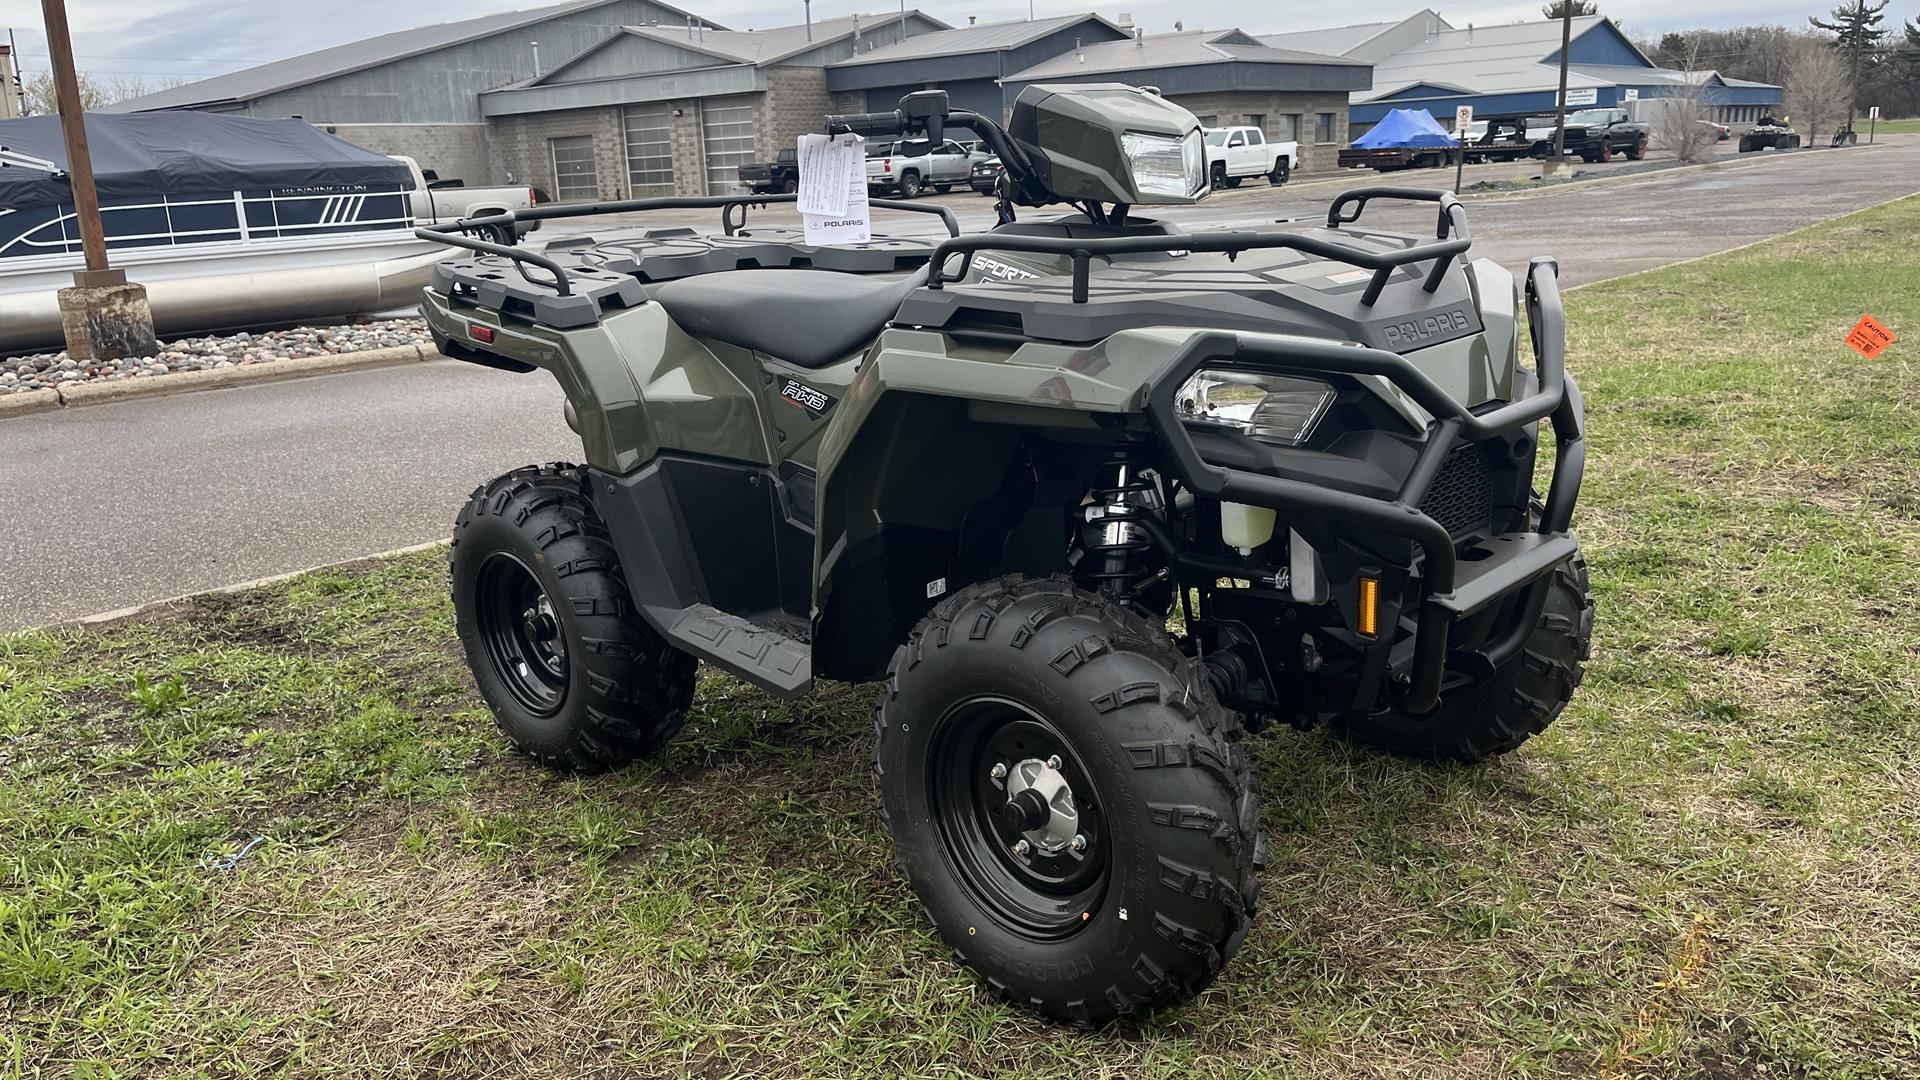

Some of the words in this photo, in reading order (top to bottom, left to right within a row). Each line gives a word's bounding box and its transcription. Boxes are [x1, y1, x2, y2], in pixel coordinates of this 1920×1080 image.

[824, 219, 864, 228] POLARIS
[972, 255, 1041, 281] SPORT
[1383, 310, 1468, 347] POLARIS
[1864, 321, 1890, 341] CAUTION
[781, 384, 826, 410] AWD
